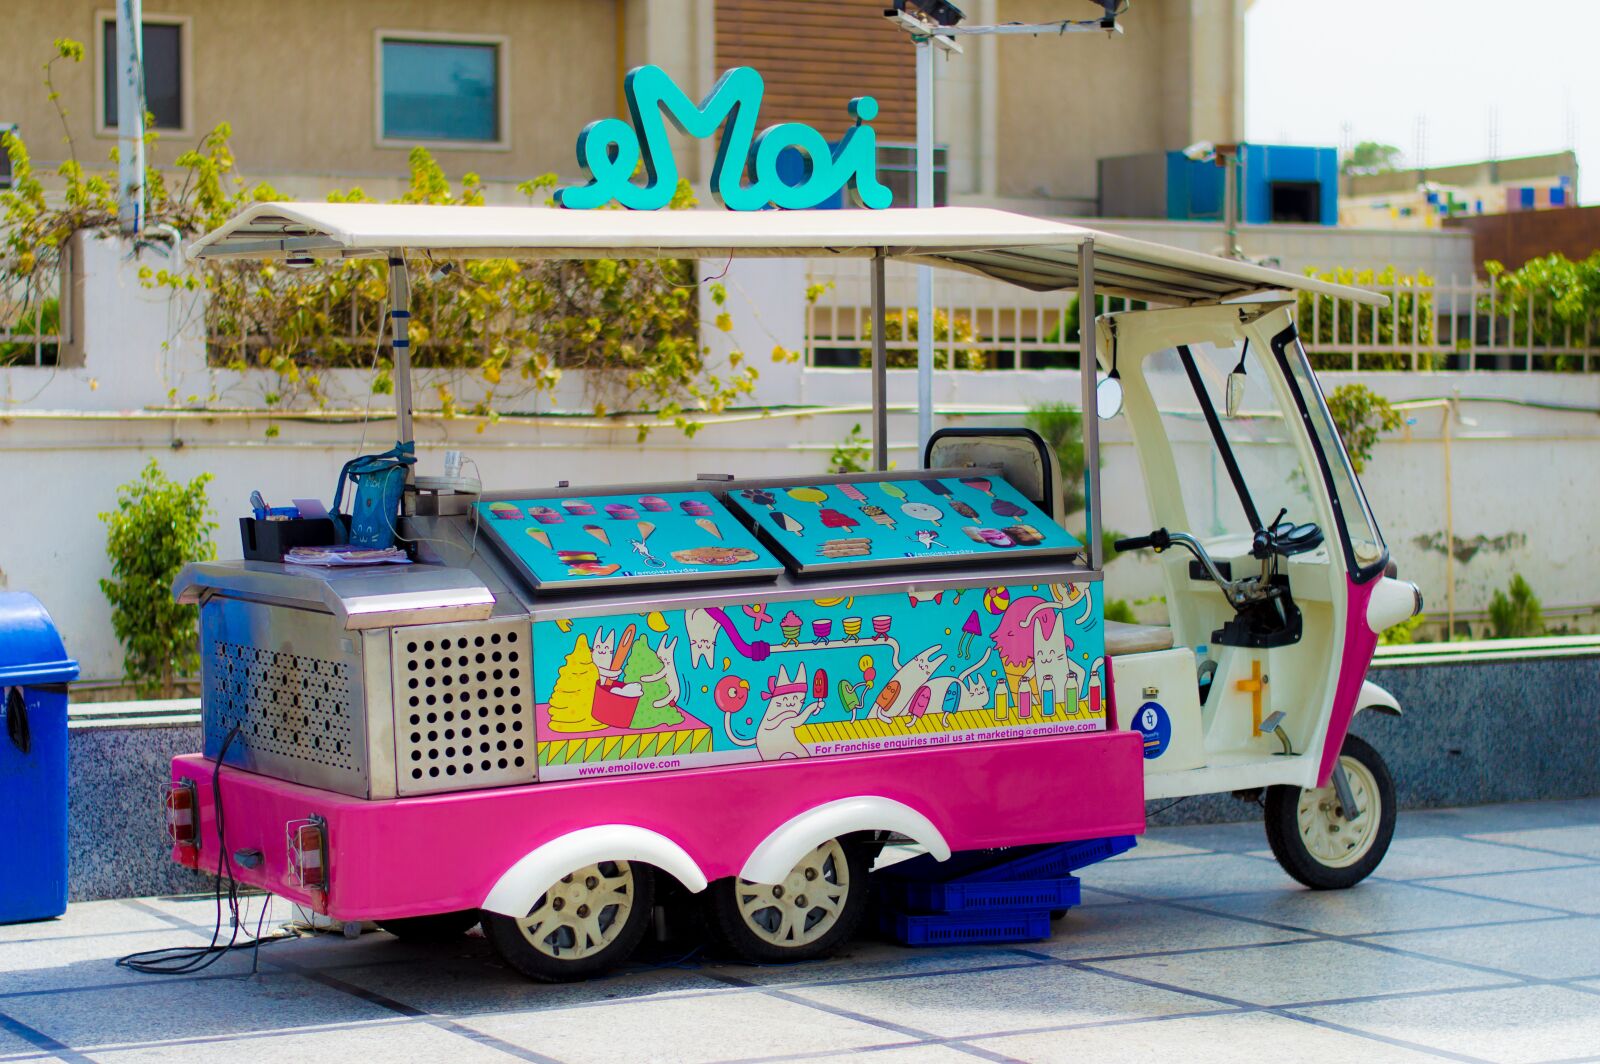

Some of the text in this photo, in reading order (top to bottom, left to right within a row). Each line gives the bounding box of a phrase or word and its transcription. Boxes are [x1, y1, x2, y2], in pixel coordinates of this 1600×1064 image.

[553, 64, 893, 212] eMoi
[815, 745, 832, 755] For
[834, 741, 881, 753] Franchise
[883, 737, 928, 749] enquiries
[930, 734, 950, 745] mail
[965, 732, 975, 741] at
[578, 759, 680, 775] www.emoilove.com
